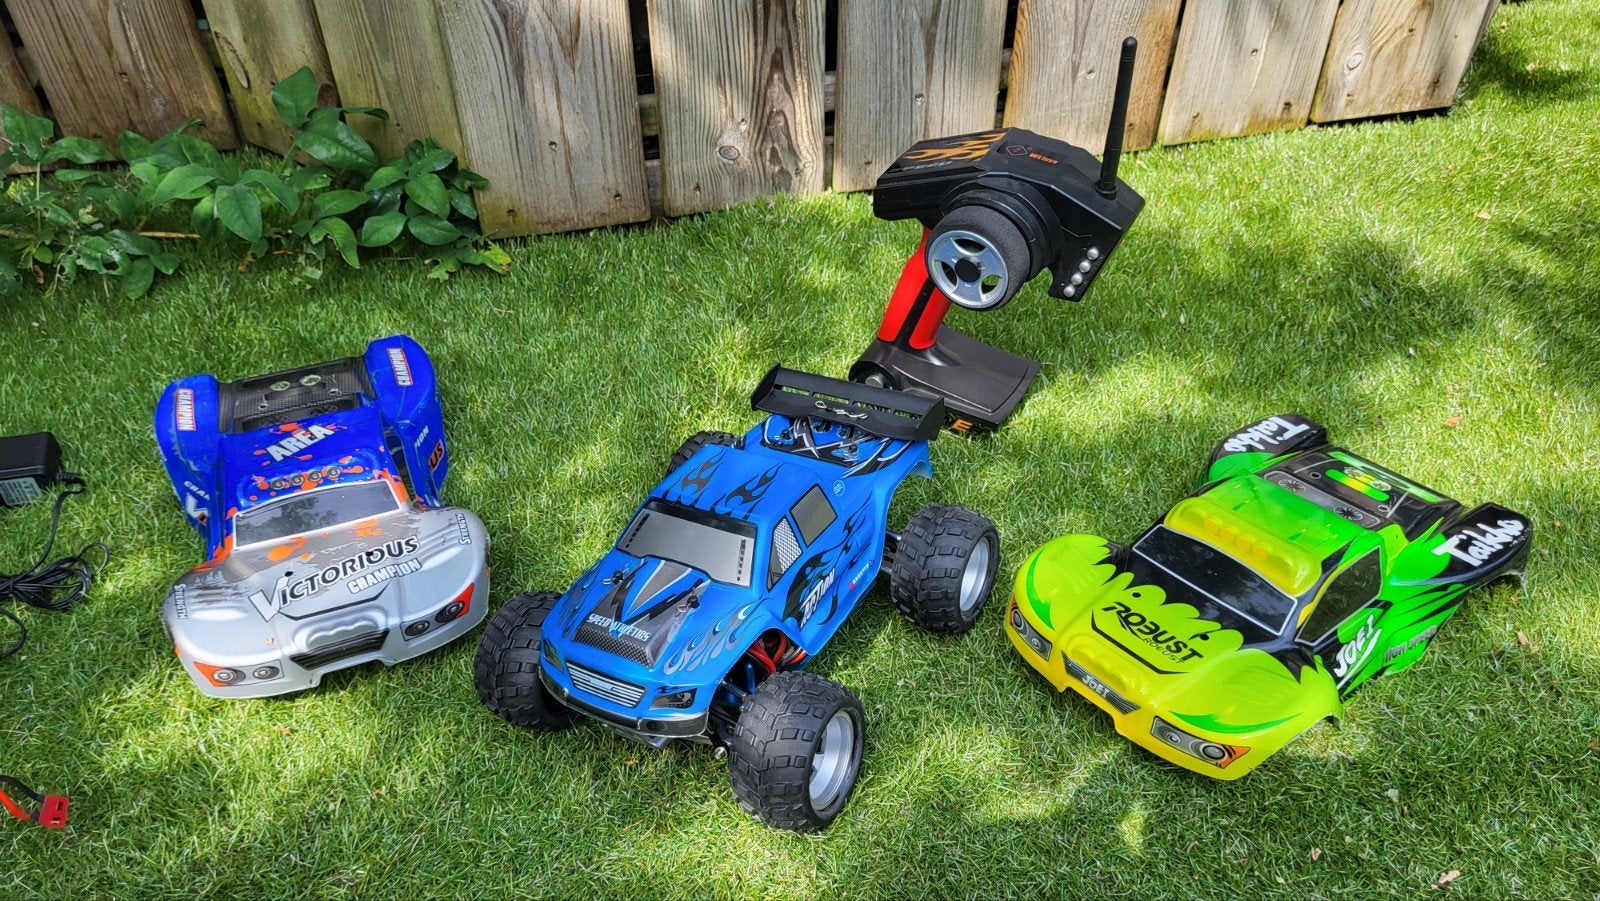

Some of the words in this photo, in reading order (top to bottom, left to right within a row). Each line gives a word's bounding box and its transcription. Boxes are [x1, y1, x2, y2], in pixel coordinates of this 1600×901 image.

[388, 348, 412, 386] CHAMPION
[177, 388, 196, 431] CHAMPION
[266, 424, 335, 463] AREA
[458, 512, 472, 545] STRENGTH
[248, 536, 419, 622] VICTORIOUS
[346, 558, 422, 594] CHAMPION
[173, 582, 187, 620] STRENGTH
[587, 613, 612, 628] SPEED
[1102, 601, 1203, 662] ROBUST
